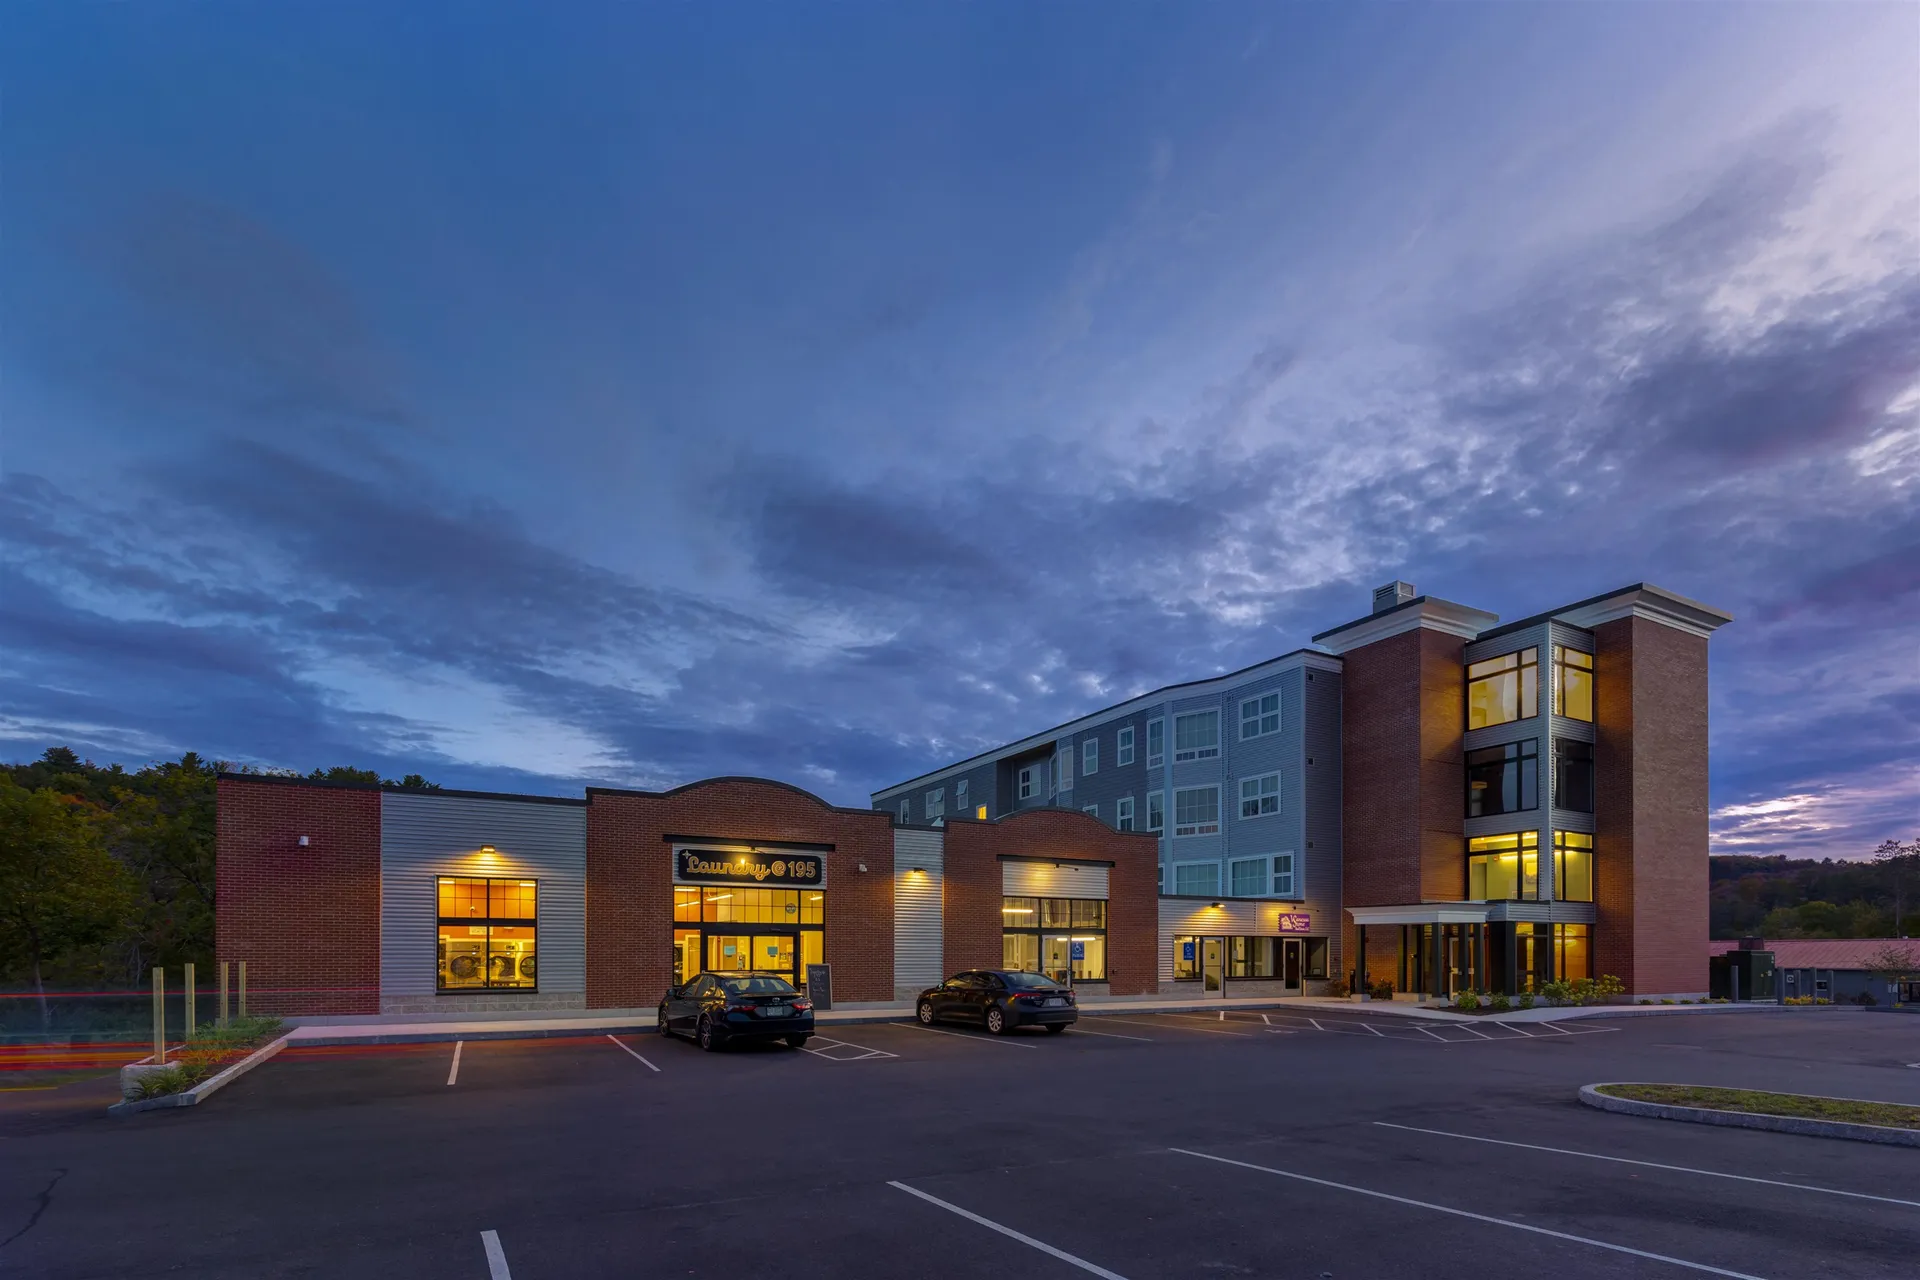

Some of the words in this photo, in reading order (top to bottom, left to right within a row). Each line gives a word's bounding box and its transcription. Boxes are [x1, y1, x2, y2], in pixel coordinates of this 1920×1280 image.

[687, 856, 771, 880] Laundry
[772, 860, 786, 876] @
[788, 860, 816, 878] 195
